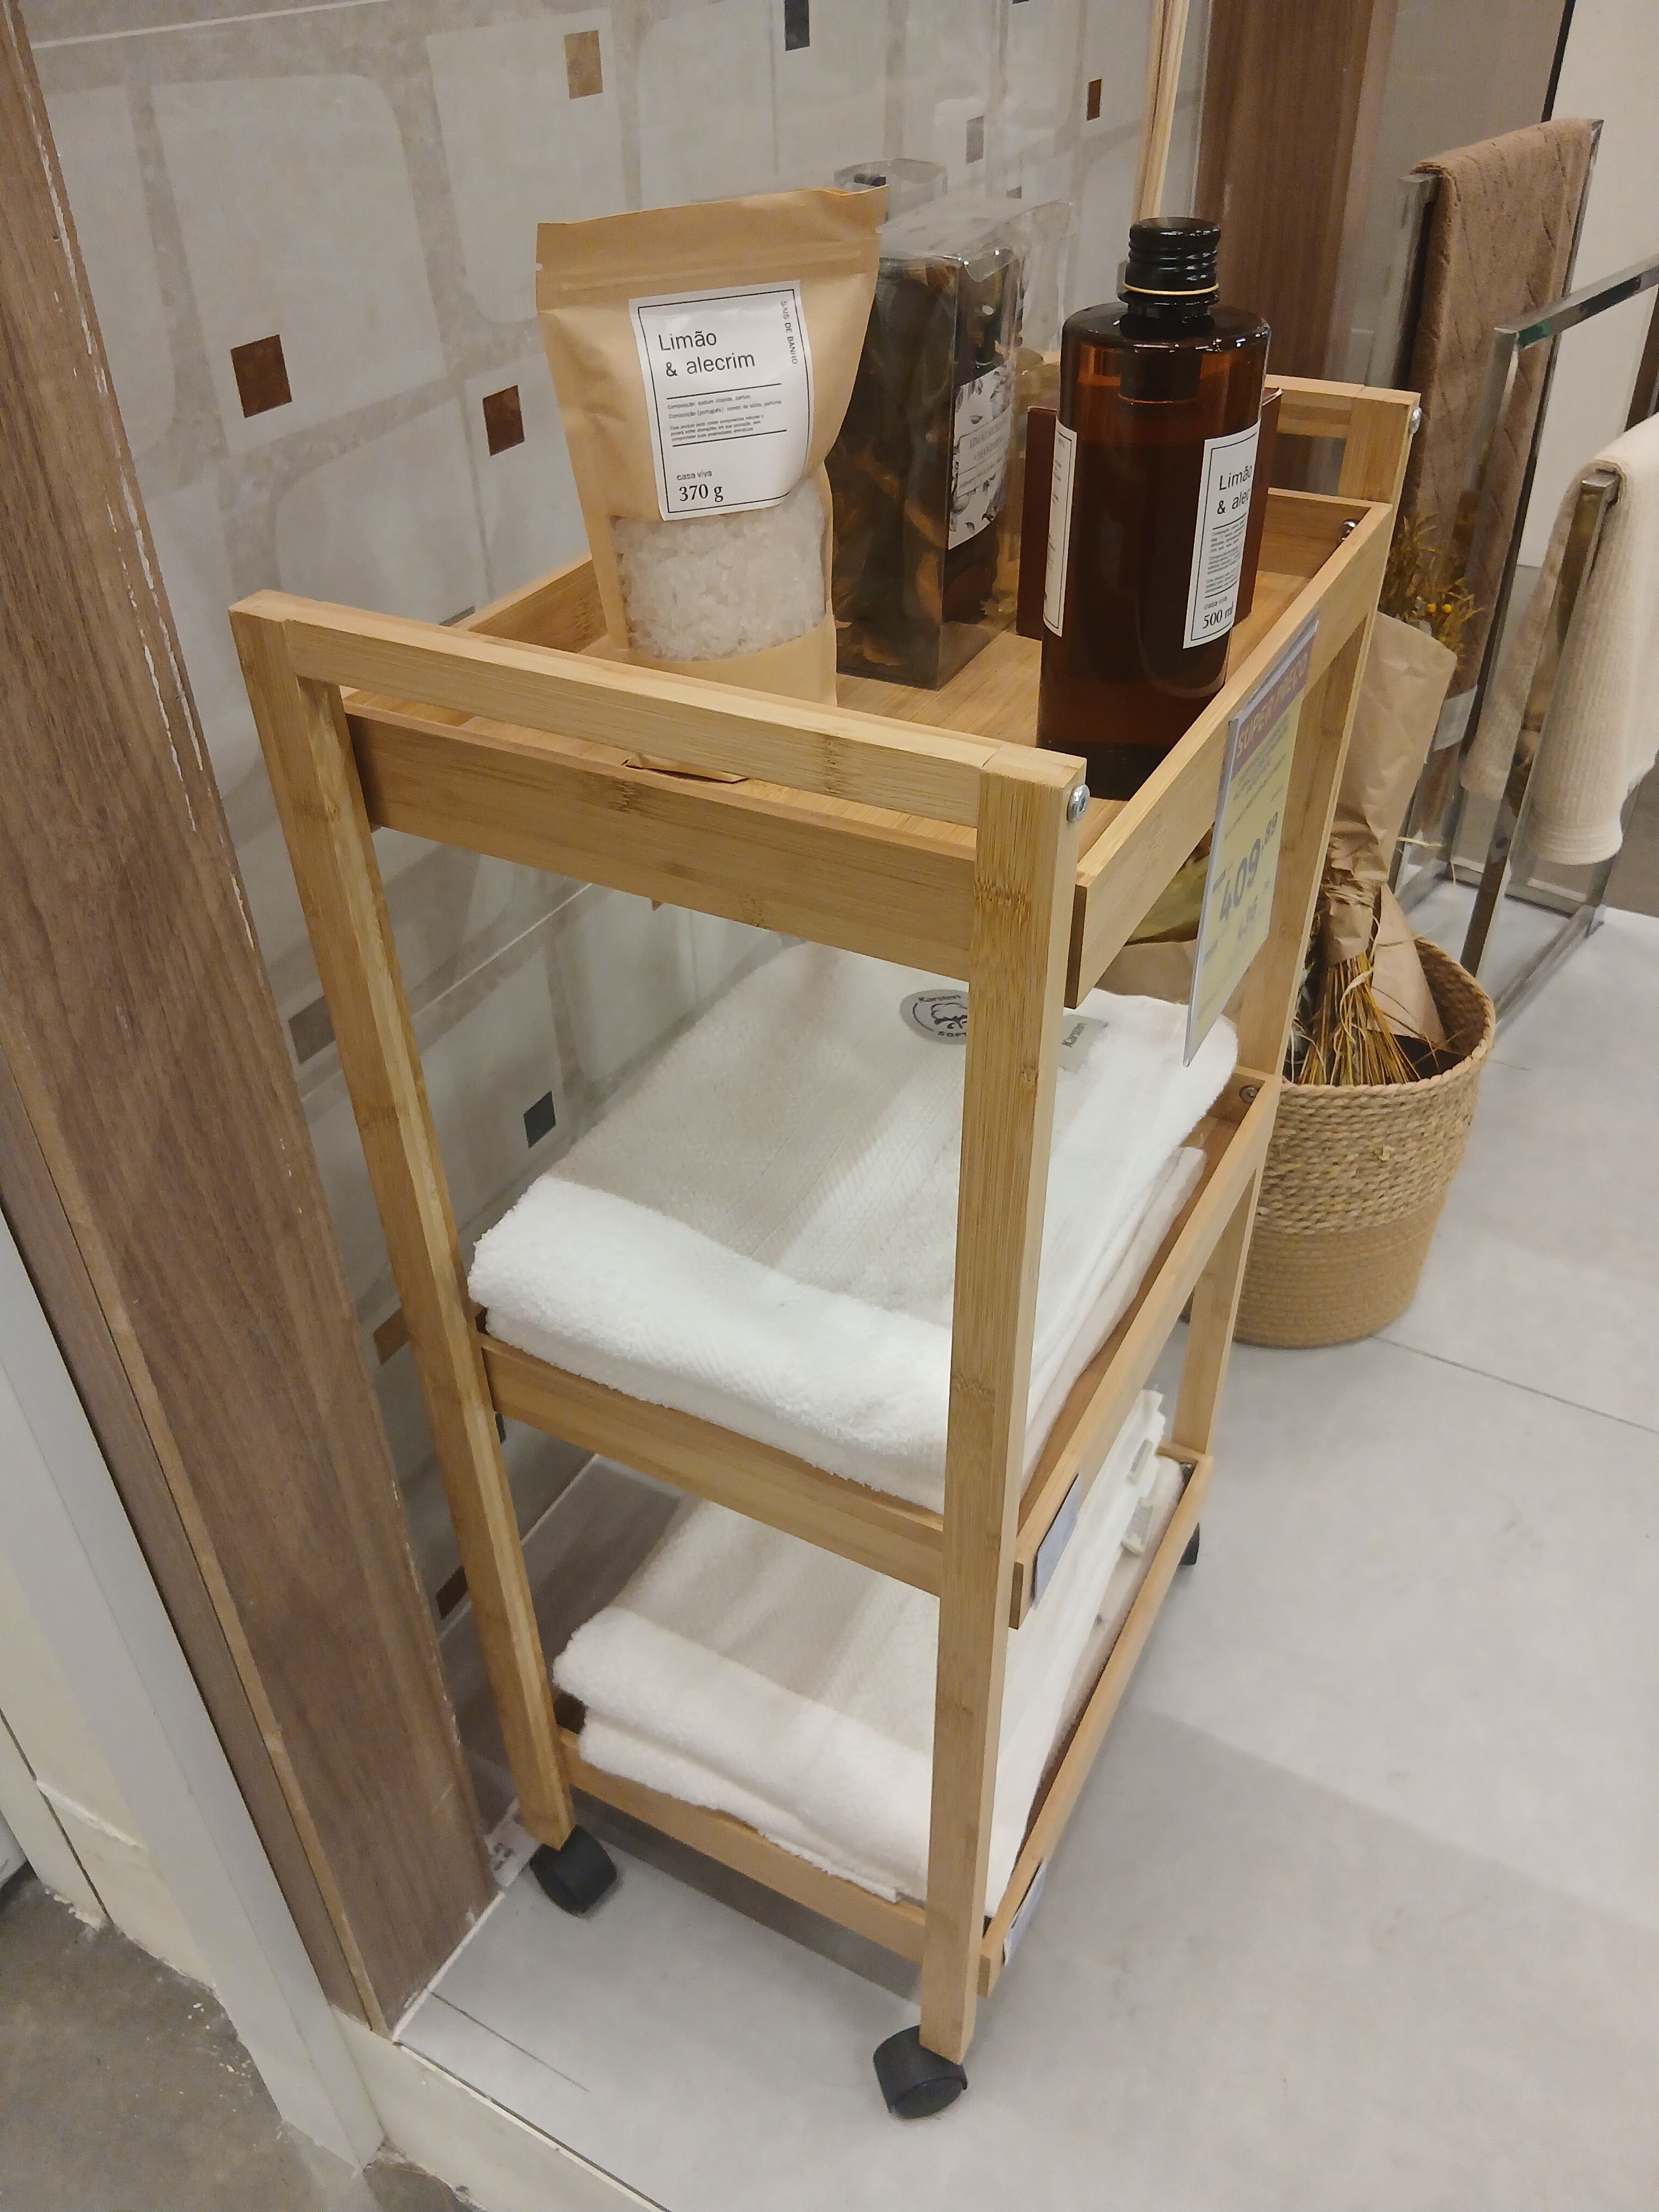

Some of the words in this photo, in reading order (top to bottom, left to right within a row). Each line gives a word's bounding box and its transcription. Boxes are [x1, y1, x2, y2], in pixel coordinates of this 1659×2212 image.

[781, 300, 790, 320] SAIS
[785, 322, 793, 333] DE
[658, 331, 717, 351] Limão
[787, 336, 799, 364] BANHO
[666, 362, 678, 377] &
[686, 352, 755, 374] alecrim
[1219, 465, 1252, 490] Limão
[679, 484, 709, 501] 370
[714, 486, 724, 503] g
[1217, 500, 1225, 515] &
[1202, 609, 1223, 629] 500
[1061, 1023, 1086, 1048] Karsten
